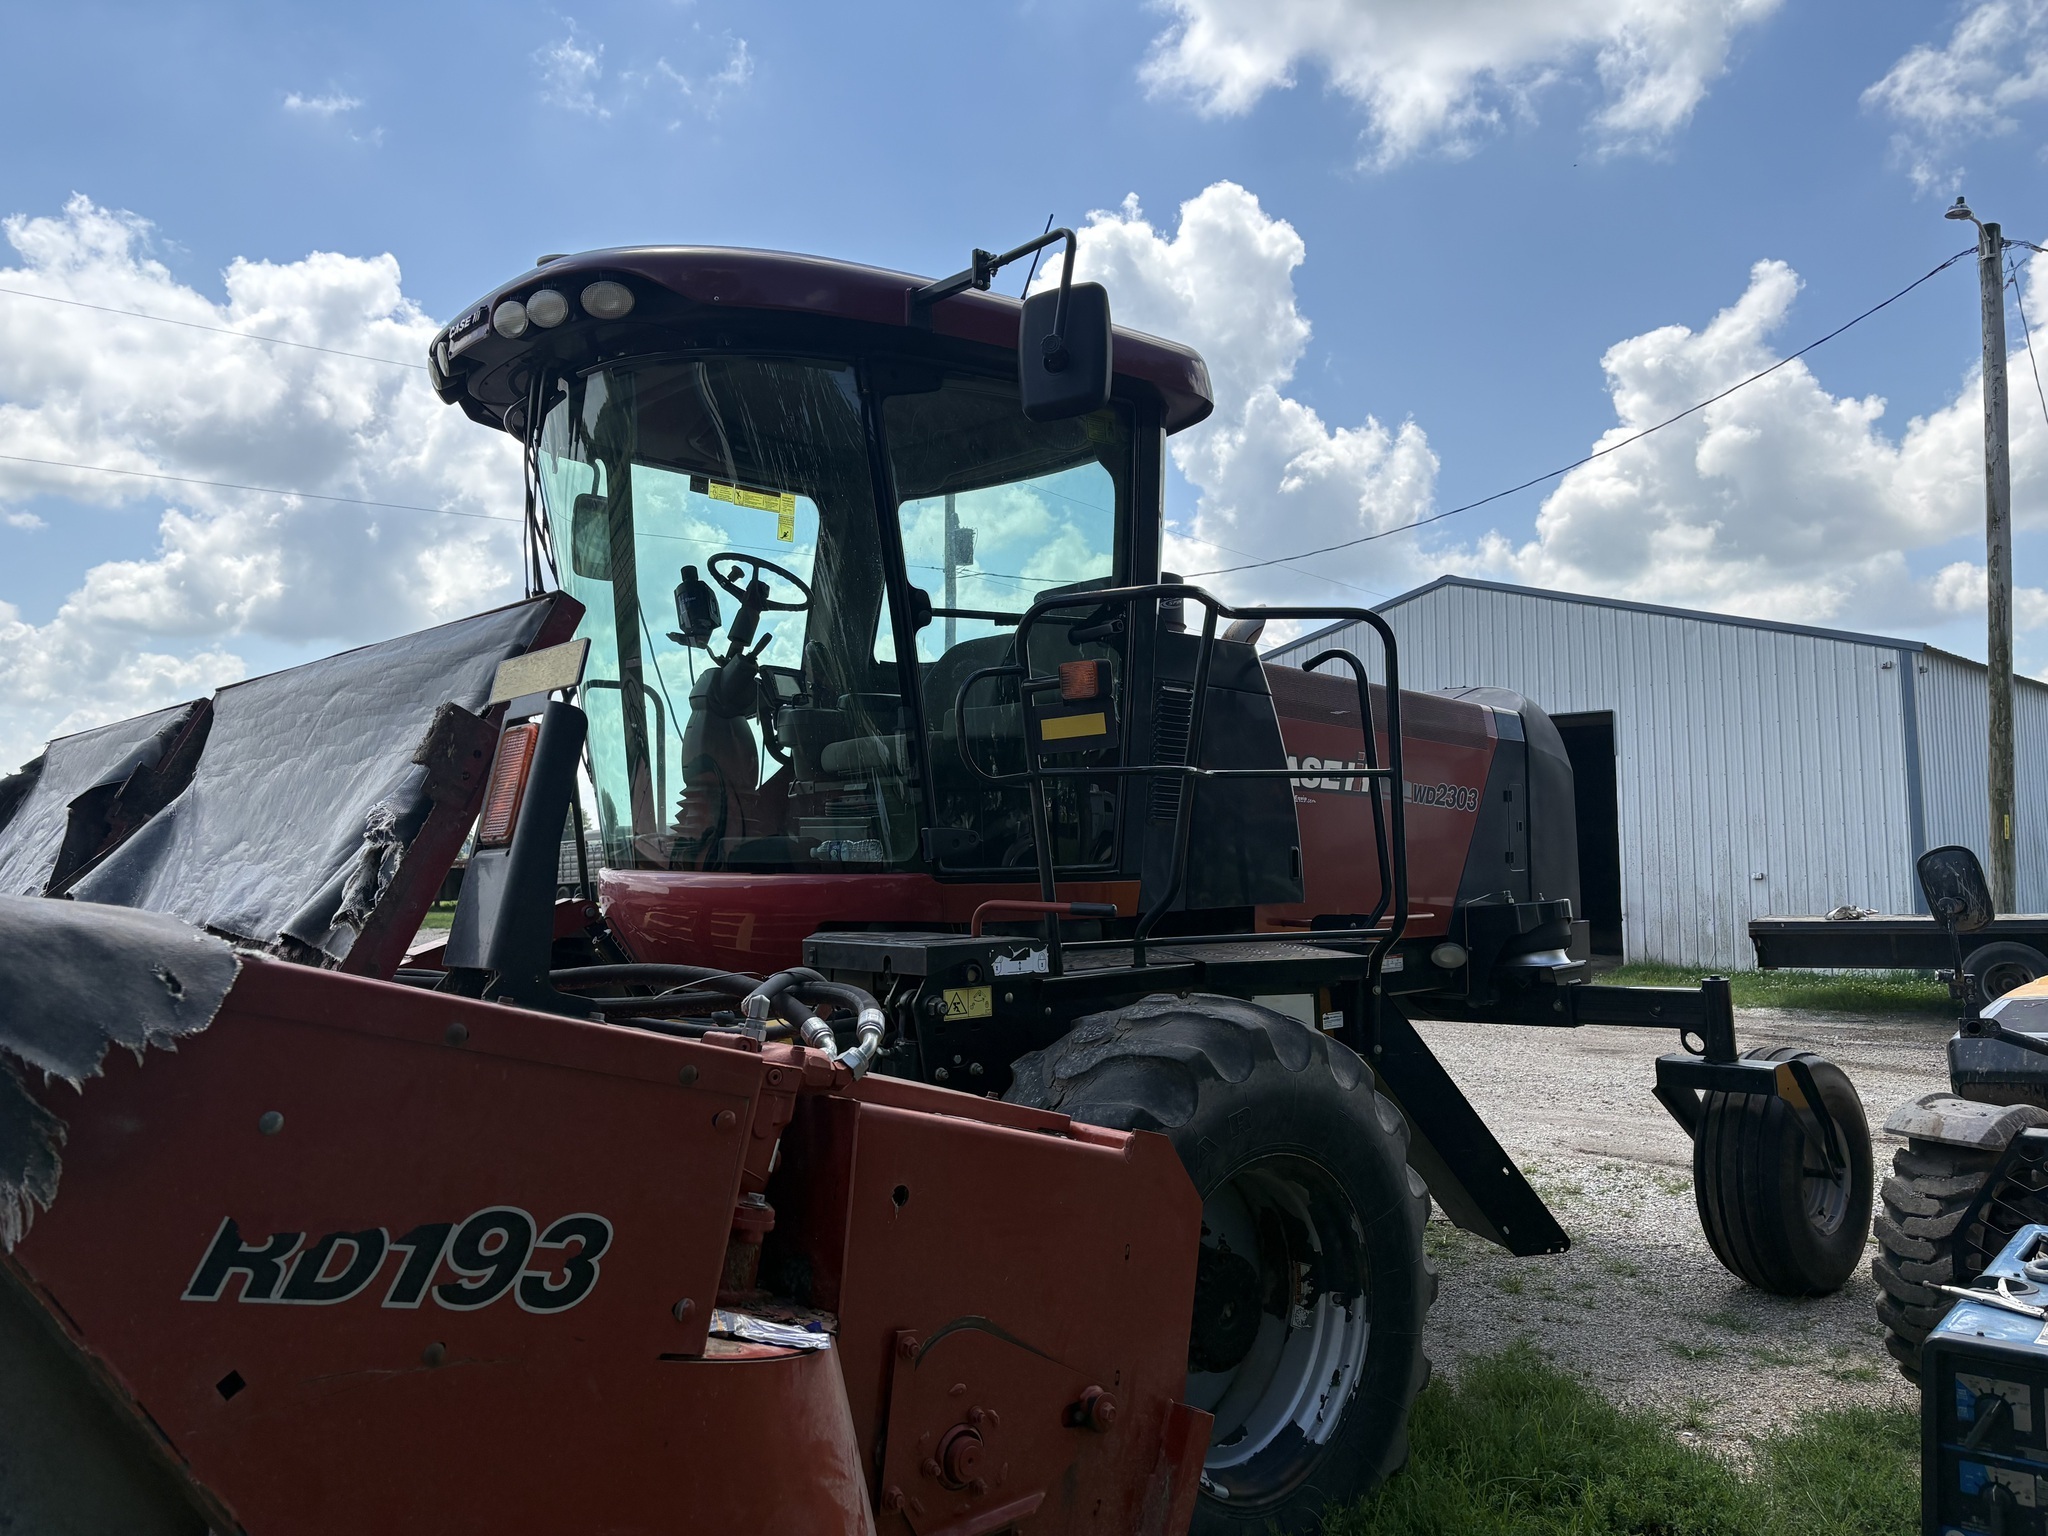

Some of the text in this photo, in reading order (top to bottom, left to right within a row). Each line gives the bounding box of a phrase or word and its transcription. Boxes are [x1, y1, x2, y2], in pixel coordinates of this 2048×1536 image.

[448, 314, 472, 339] CASE
[1287, 756, 1343, 790] ASE
[1412, 782, 1479, 812] WD2303
